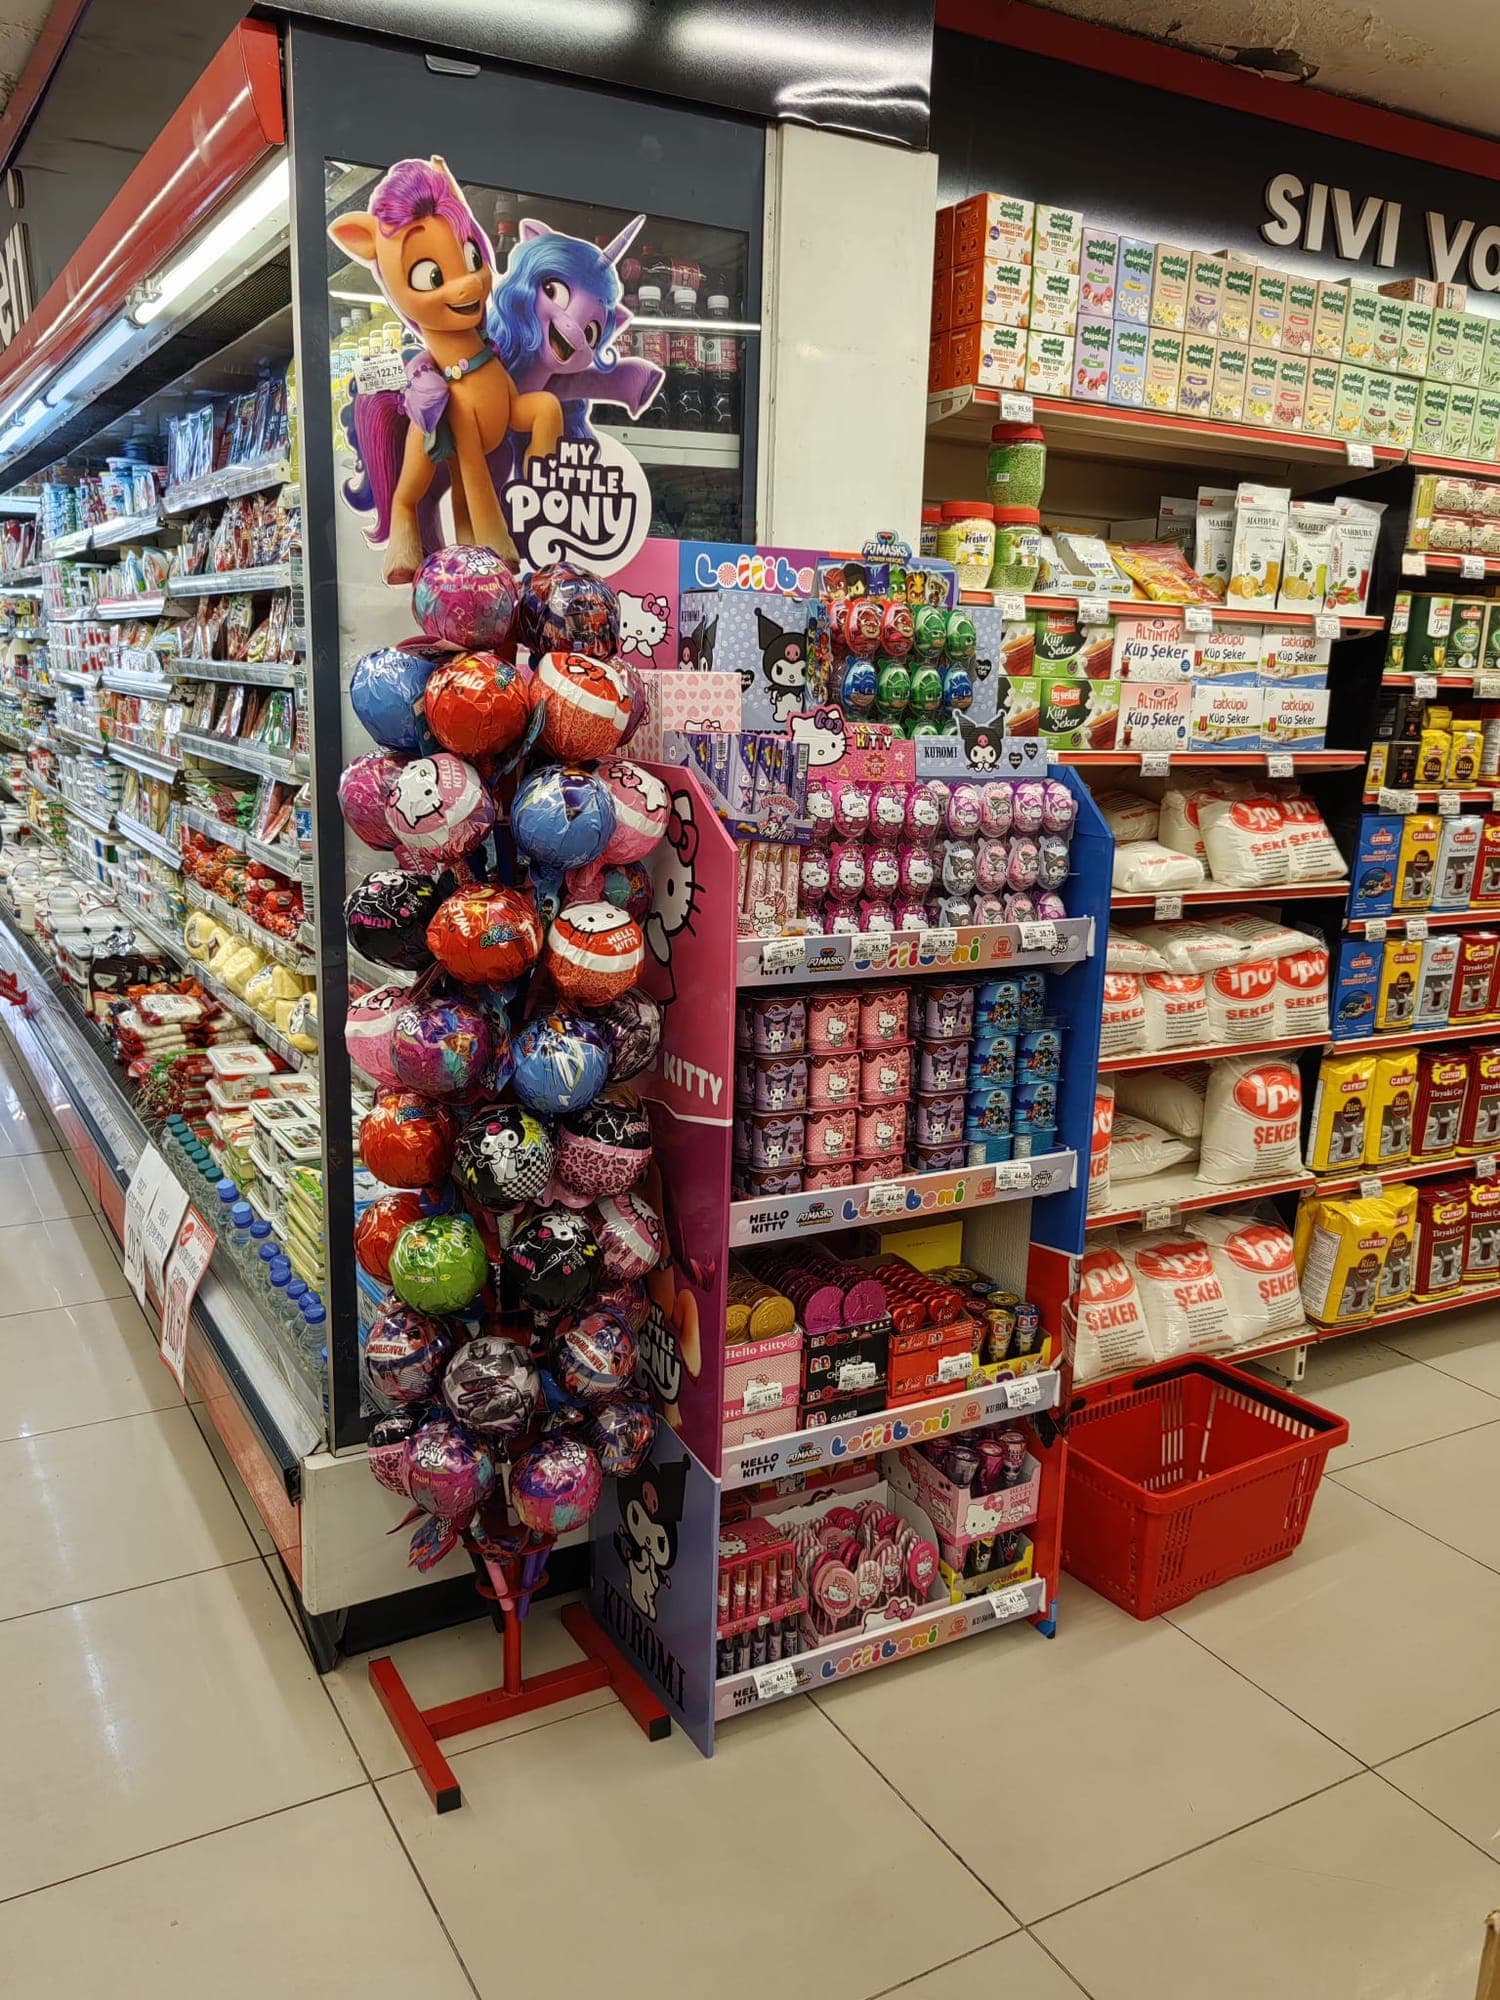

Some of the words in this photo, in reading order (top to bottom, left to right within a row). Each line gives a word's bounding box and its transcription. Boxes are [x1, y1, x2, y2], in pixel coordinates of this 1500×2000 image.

[1262, 173, 1402, 268] SIVI
[561, 441, 594, 466] MY
[505, 484, 632, 560] PONY
[695, 553, 814, 594] Lollibo
[1124, 643, 1149, 658] Küp
[1150, 644, 1189, 661] Şeker
[1126, 712, 1149, 726] Küp
[1151, 713, 1184, 729] Şeker
[924, 746, 959, 759] KUROMI
[663, 1051, 724, 1107] KITTY
[1253, 1121, 1298, 1150] ŞEKER
[749, 1209, 790, 1224] HELLO
[751, 1220, 786, 1234] KITTY
[1173, 1280, 1224, 1312] ŞEKER
[1085, 1301, 1139, 1338] ŞEKER
[725, 1347, 757, 1360] Hello
[760, 1340, 786, 1354] Kitty
[830, 1409, 858, 1423] GAMER
[831, 1408, 951, 1458] Lolliboni
[740, 1452, 780, 1470] HELLO
[742, 1463, 777, 1479] KITTY
[601, 1576, 686, 1713] KUROMI
[820, 1624, 938, 1681] Lolliboni
[733, 1686, 755, 1698] HEL
[735, 1693, 759, 1708] KITT
